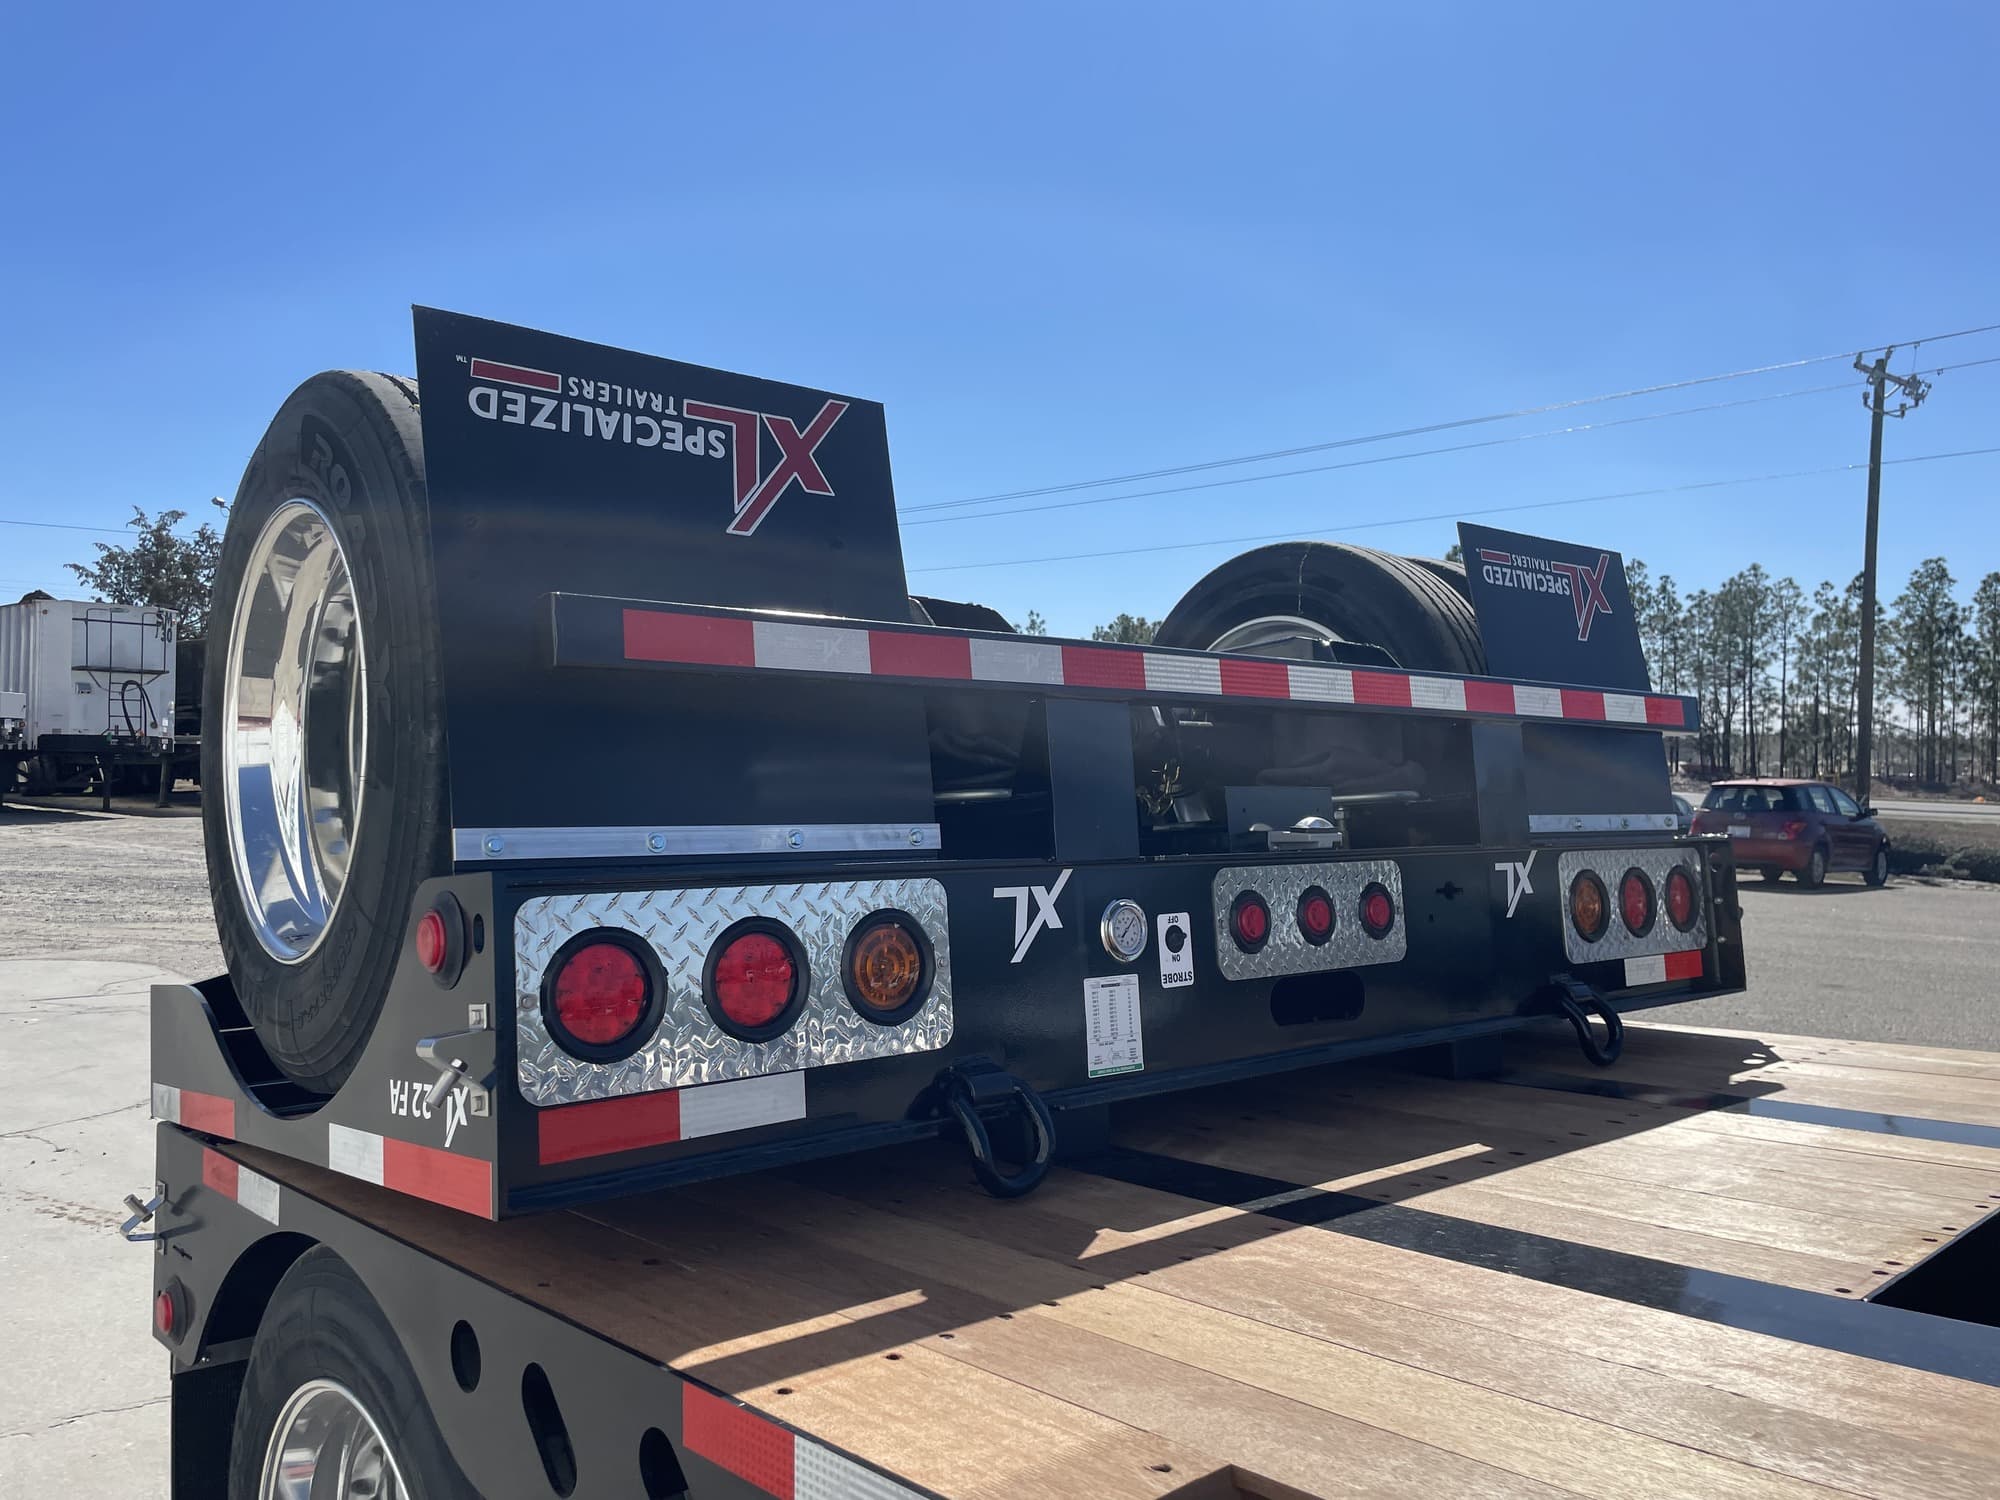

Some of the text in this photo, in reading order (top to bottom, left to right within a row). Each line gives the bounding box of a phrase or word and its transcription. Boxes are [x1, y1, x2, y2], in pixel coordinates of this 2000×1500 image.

[568, 376, 678, 416] TRAILERS
[468, 386, 726, 459] SPECIALIZED
[683, 399, 850, 537] XL
[1482, 564, 1571, 596] SPECIALIZED
[1511, 553, 1551, 572] TRAILERS
[1550, 553, 1613, 642] XL
[1495, 849, 1538, 918] XL
[992, 868, 1074, 964] XL
[1167, 914, 1179, 925] OFF
[1162, 970, 1193, 985] STROBE
[1171, 953, 1181, 963] ON
[389, 1078, 409, 1116] FA
[412, 1081, 433, 1120] 22
